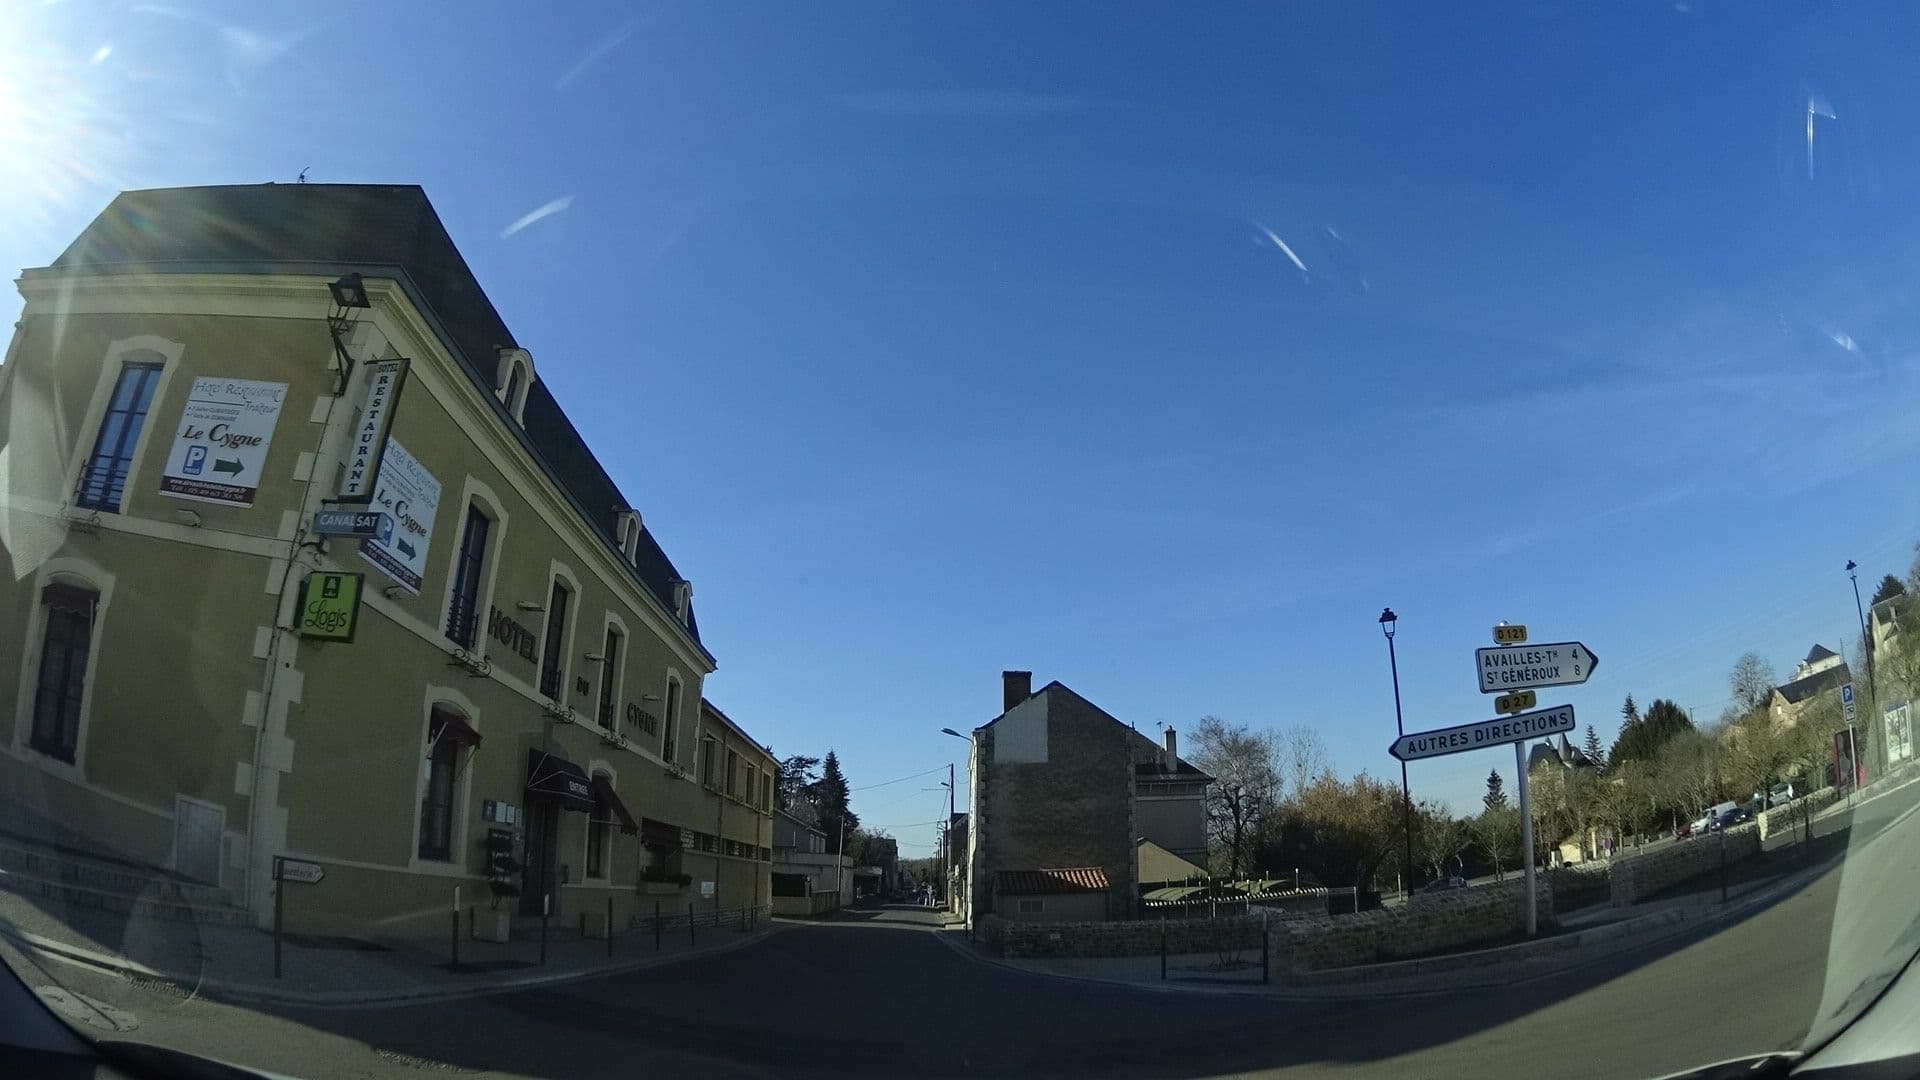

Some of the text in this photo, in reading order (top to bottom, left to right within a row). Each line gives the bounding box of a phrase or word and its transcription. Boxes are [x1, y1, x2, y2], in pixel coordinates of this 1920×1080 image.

[182, 423, 263, 449] Le Cygne
[348, 375, 389, 493] RESTAURANT
[377, 488, 392, 508] Le
[395, 500, 427, 537] Cygne
[304, 600, 348, 633] Logis
[487, 605, 538, 664] HOTEL
[1498, 628, 1525, 640] D 121
[1571, 648, 1578, 660] 4
[1501, 665, 1561, 683] GÉNÉROUX
[1574, 664, 1581, 676] 8
[1502, 695, 1529, 710] D 27
[1407, 712, 1569, 755] AUTRES DIRECTIONS
